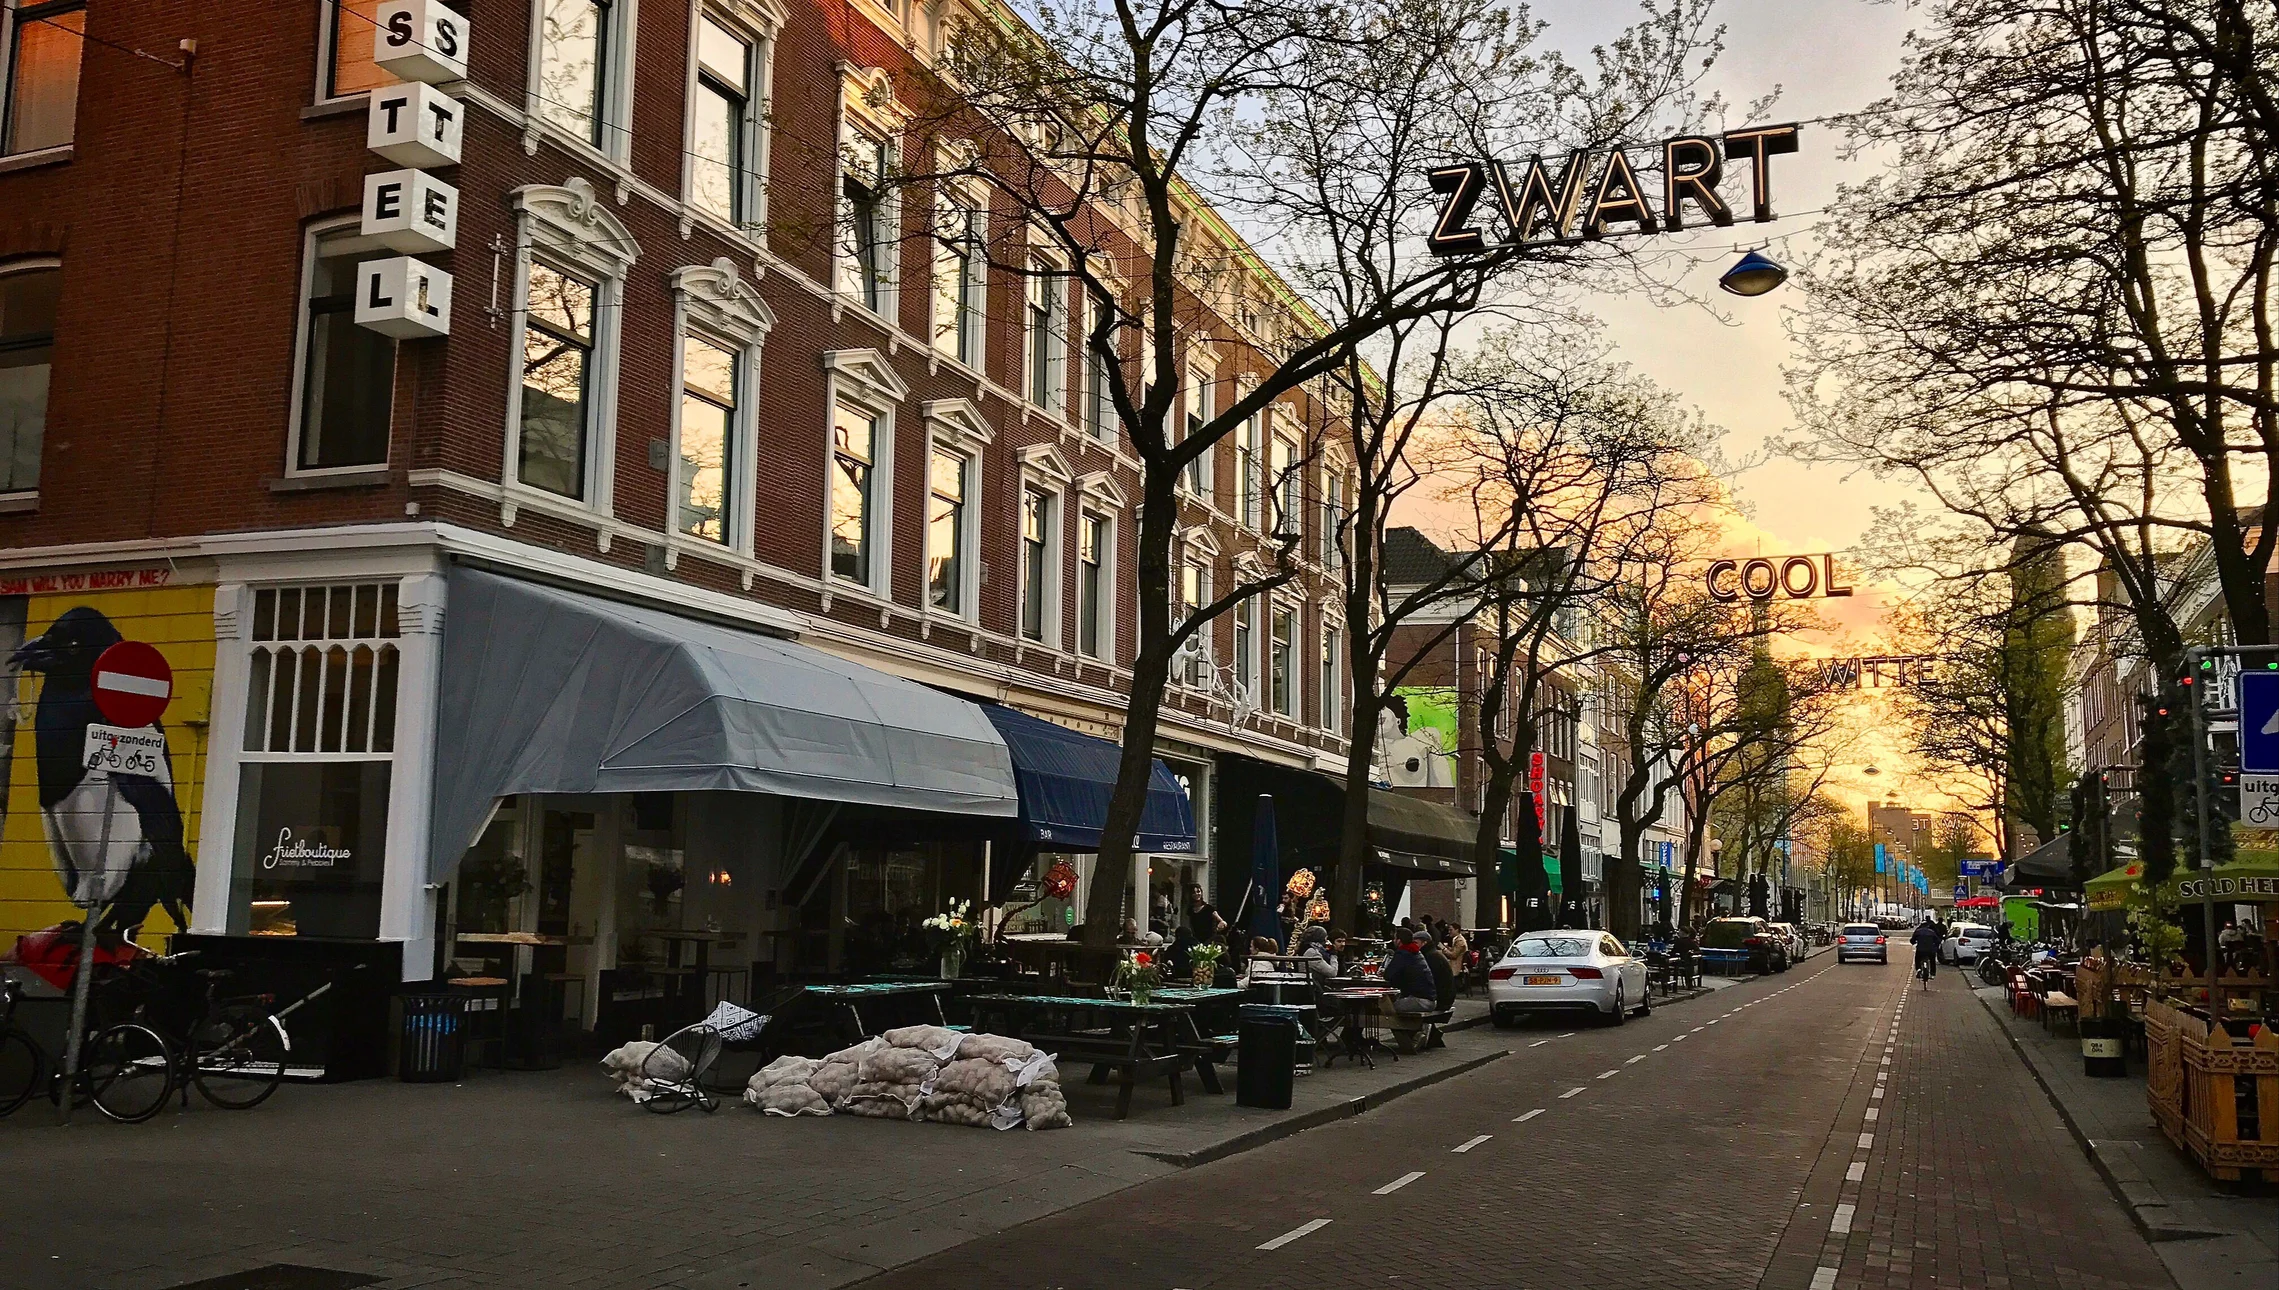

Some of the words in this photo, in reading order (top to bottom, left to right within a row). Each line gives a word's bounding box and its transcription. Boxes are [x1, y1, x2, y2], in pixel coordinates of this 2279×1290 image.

[1428, 122, 1799, 256] ZWART
[0, 577, 28, 593] SAM
[61, 573, 85, 589] YOU
[89, 570, 134, 588] MARRY
[138, 568, 170, 586] ME?
[1706, 552, 1853, 600] COOL
[1817, 656, 1938, 688] WITTE
[91, 730, 162, 748] uitgzonderd
[1040, 828, 1052, 840] BAR
[1163, 840, 1191, 851] RESTAURANT
